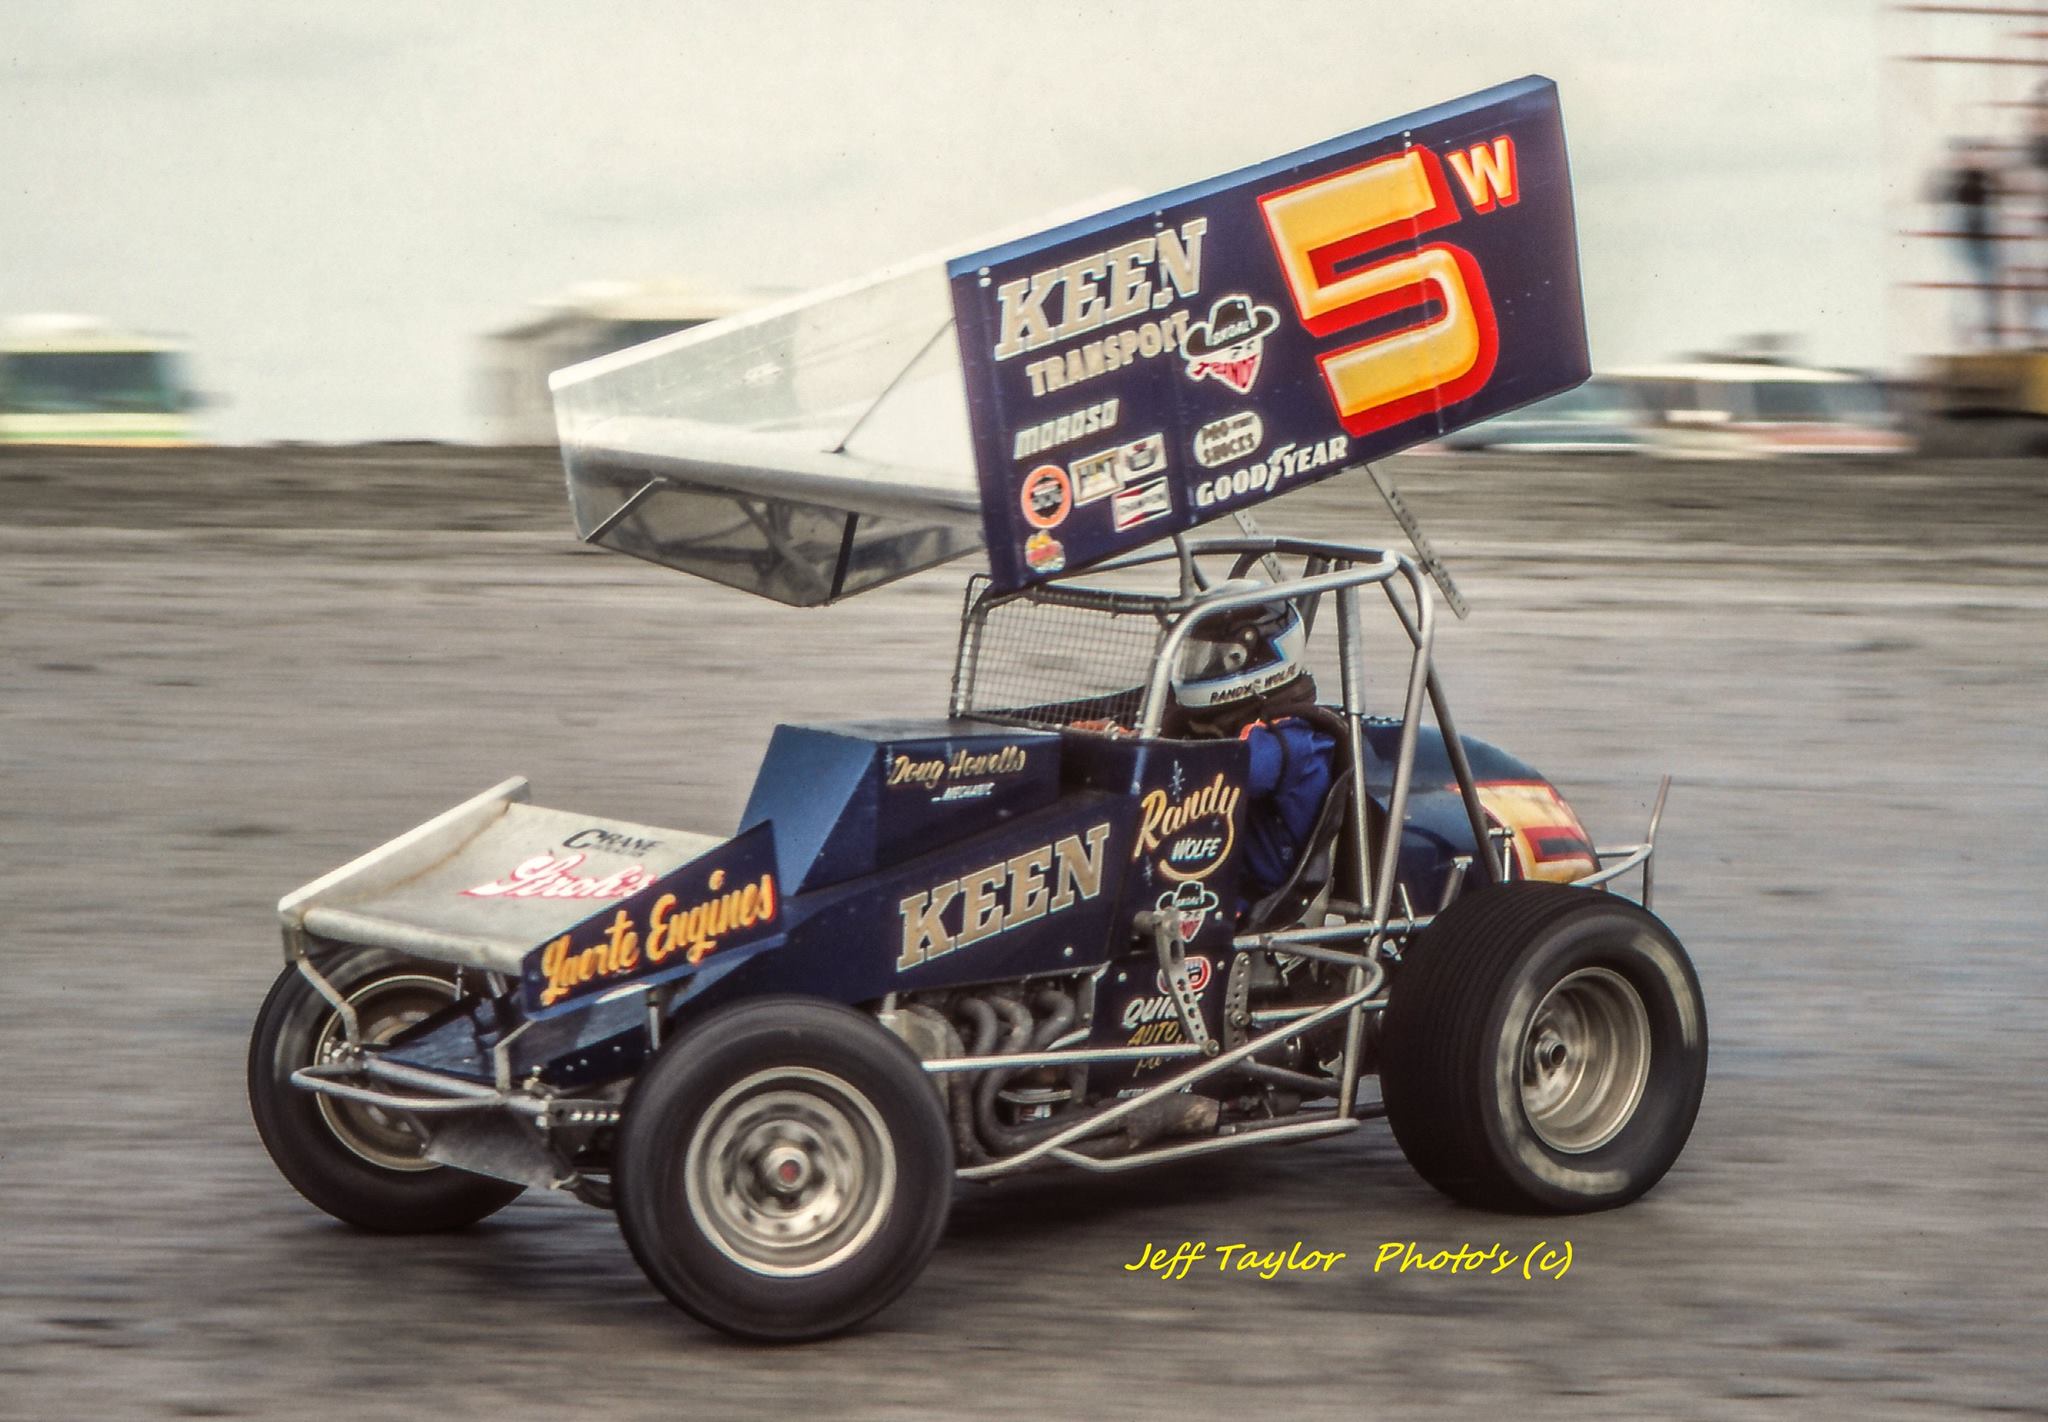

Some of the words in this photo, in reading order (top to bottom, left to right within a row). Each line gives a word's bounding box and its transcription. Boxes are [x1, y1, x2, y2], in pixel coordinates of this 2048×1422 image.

[994, 217, 1207, 361] KEEN
[1256, 143, 1499, 437] 5
[1025, 310, 1190, 396] TRANSPORT
[1196, 436, 1348, 507] GOODYEAR
[887, 755, 945, 789] Doug
[947, 745, 1026, 779] Howells
[1133, 772, 1241, 866] Randy
[1170, 837, 1222, 863] WOLFE
[645, 869, 776, 964] Engines
[896, 822, 1110, 973] KEEN
[1127, 1021, 1180, 1046] AUTO
